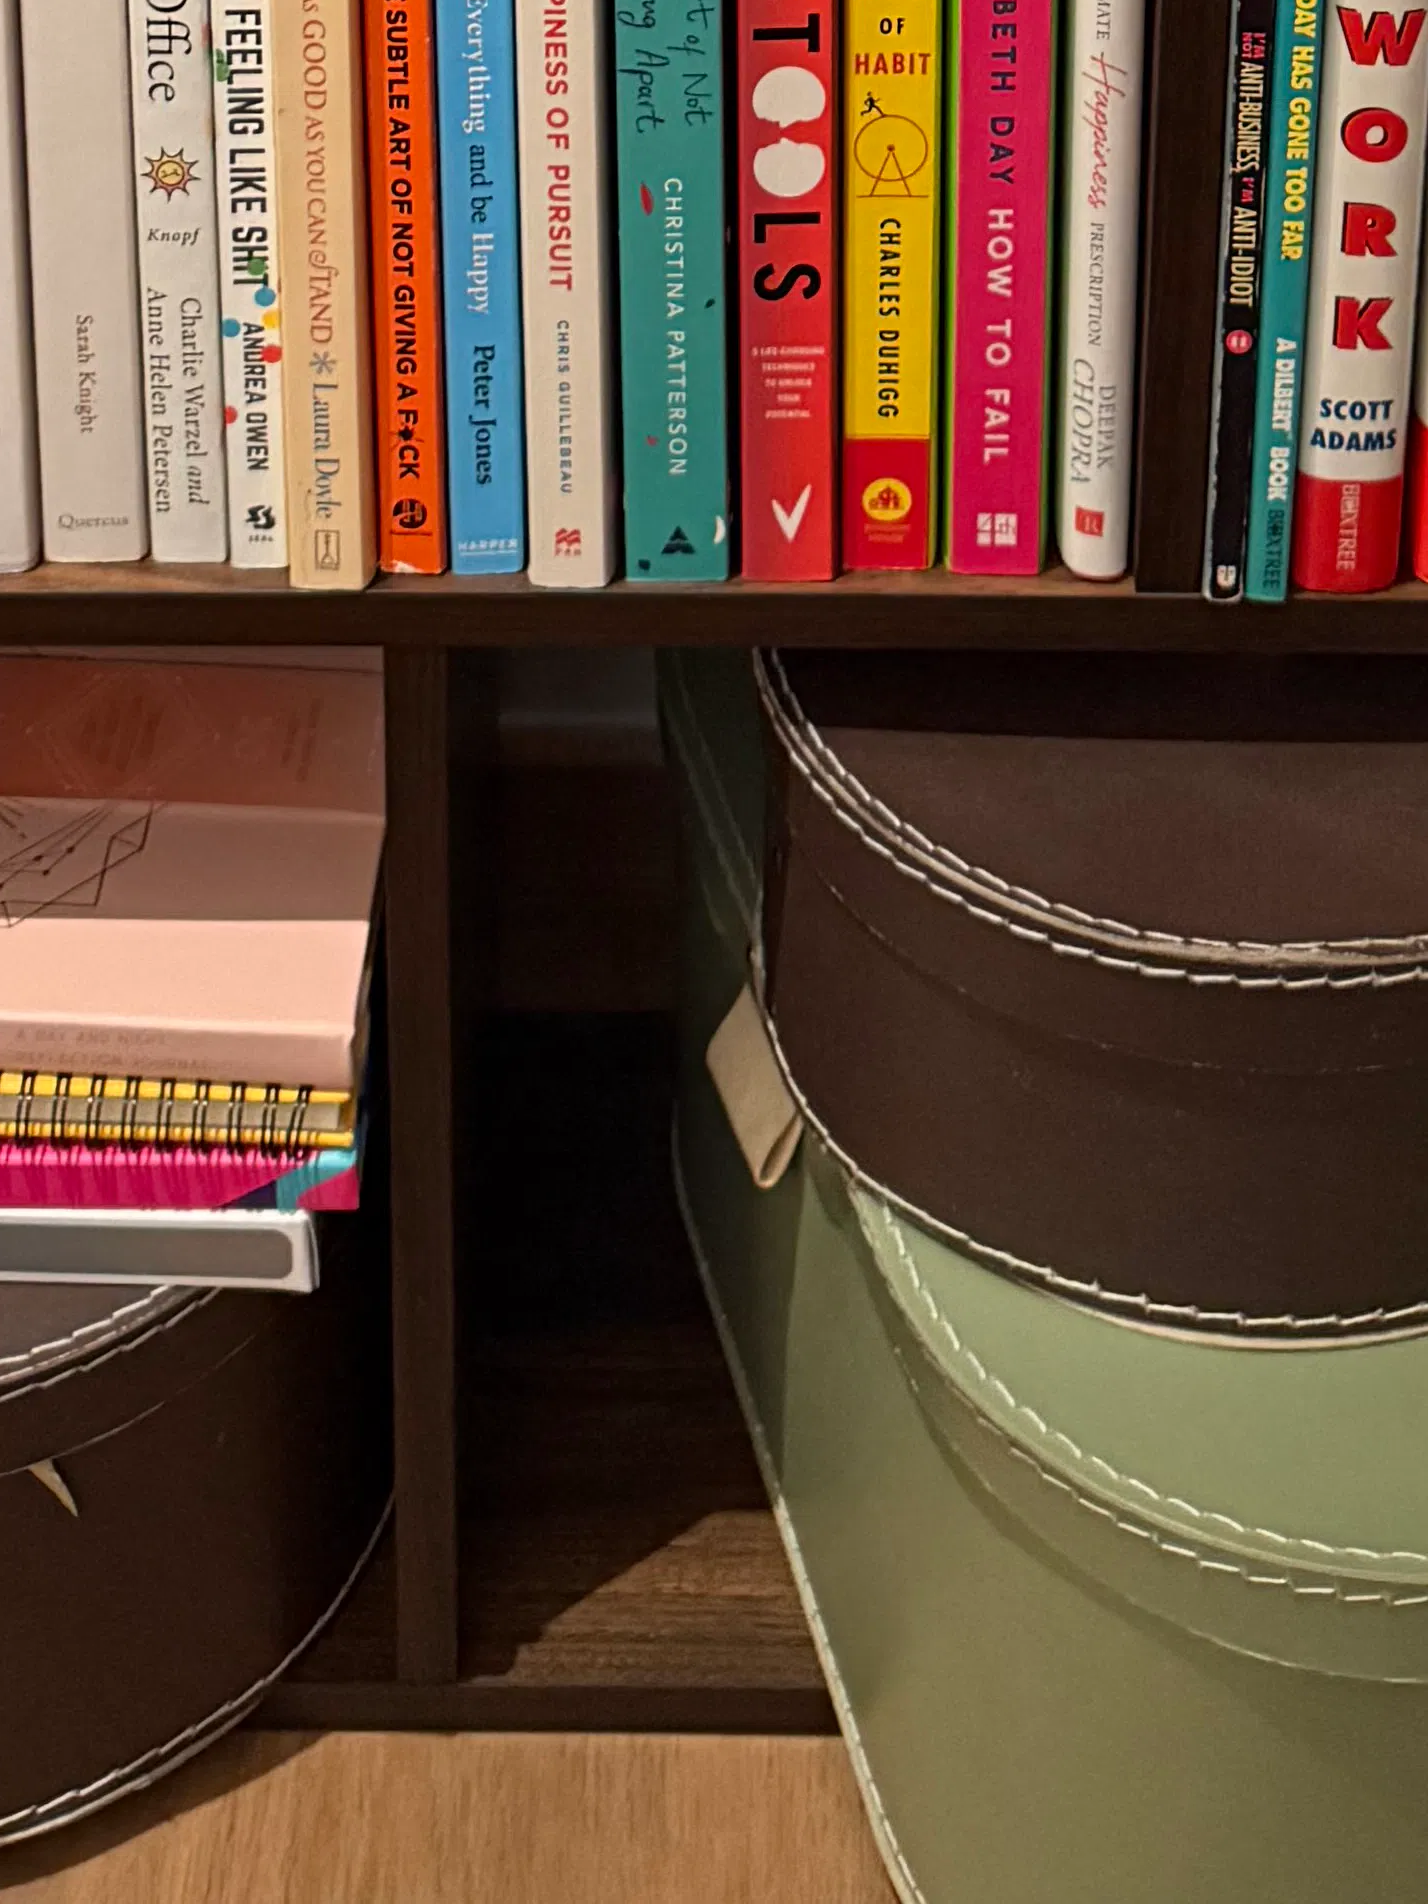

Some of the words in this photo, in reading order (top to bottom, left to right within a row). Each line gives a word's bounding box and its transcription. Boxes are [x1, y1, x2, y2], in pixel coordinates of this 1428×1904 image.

[879, 17, 907, 34] OF
[854, 51, 931, 74] HABIT
[1289, 47, 1315, 88] HAS
[543, 106, 570, 149] OF
[988, 116, 1016, 184] DAY
[1285, 98, 1312, 159] GONE
[1283, 167, 1309, 209] TOO
[545, 163, 573, 290] PURSUIT
[663, 178, 686, 315] CHRISTINA
[986, 208, 1013, 295] HOW
[1280, 222, 1306, 261] FAR
[878, 217, 902, 316] CHARLES
[877, 330, 901, 417] DUHIGG
[985, 319, 1012, 365] TO
[666, 330, 688, 474] PATTERSON
[983, 387, 1011, 463] FAIL
